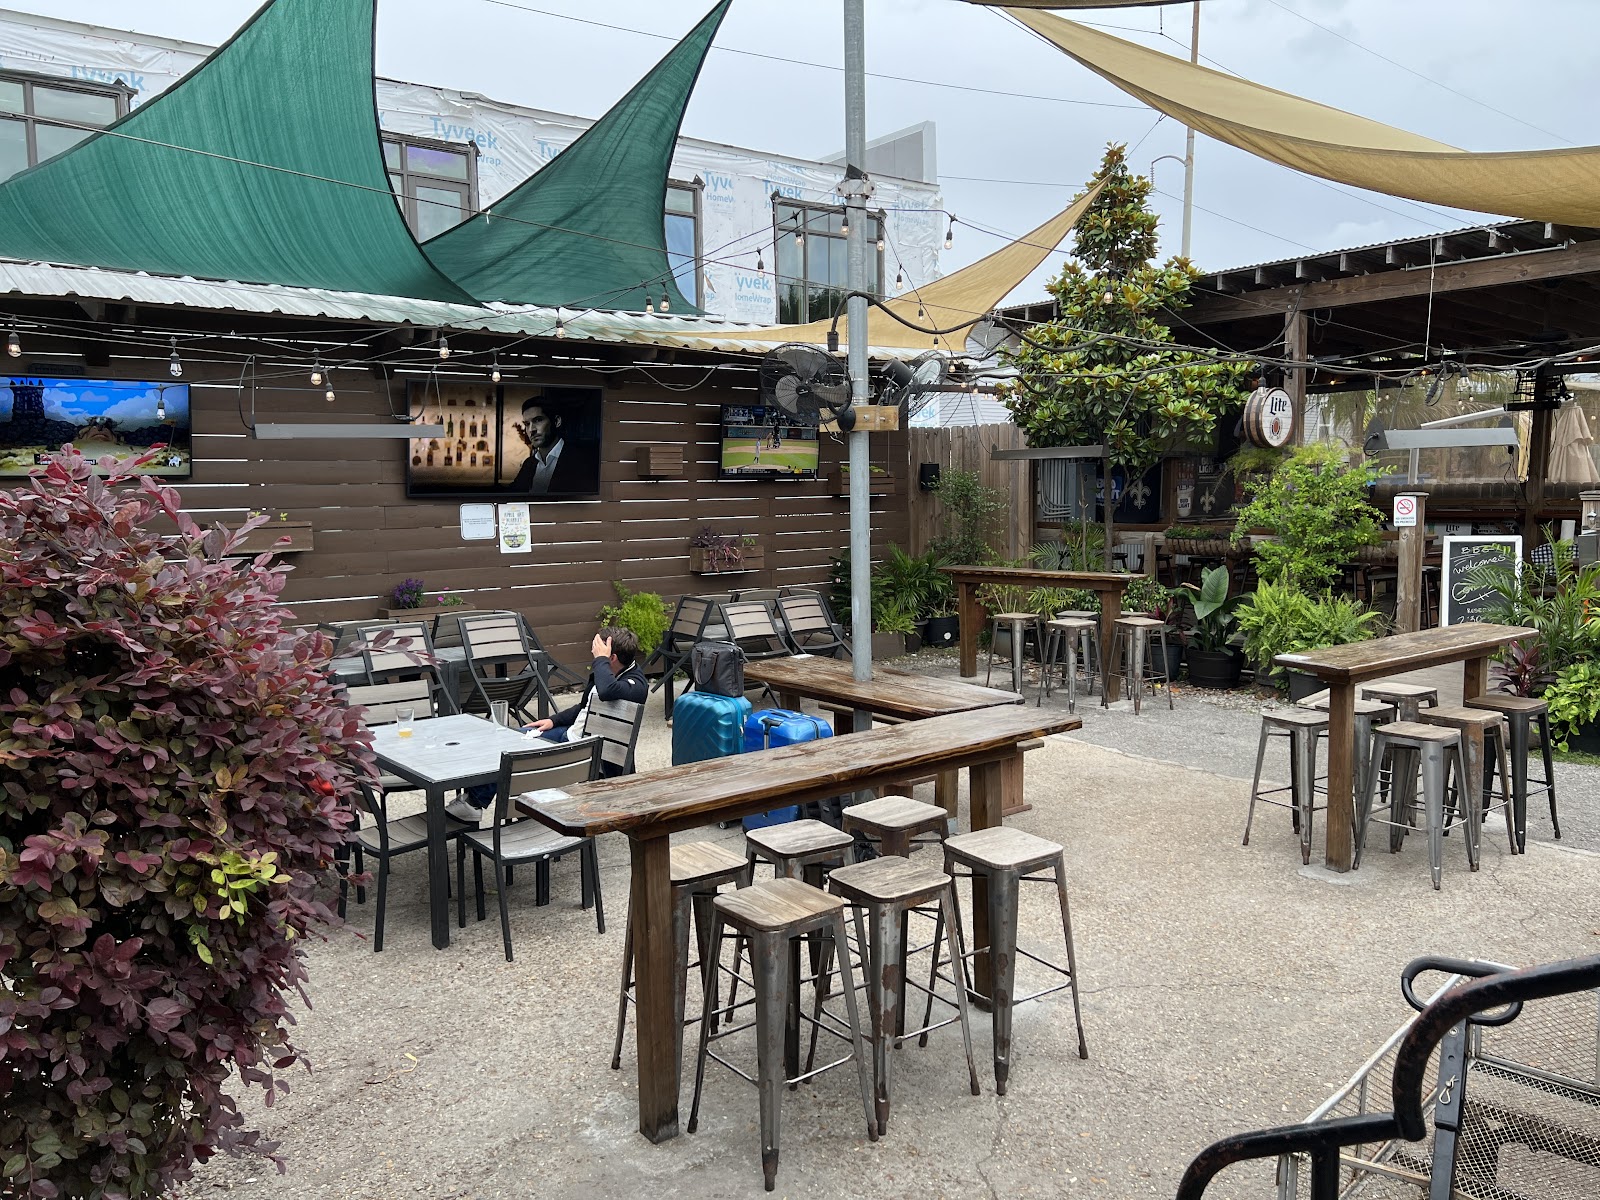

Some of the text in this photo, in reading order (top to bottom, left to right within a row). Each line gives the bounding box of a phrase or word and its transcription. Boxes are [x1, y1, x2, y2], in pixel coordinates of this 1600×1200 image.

[736, 275, 772, 292] yvek
[1270, 396, 1287, 416] Lite
[1445, 524, 1460, 532] Lite
